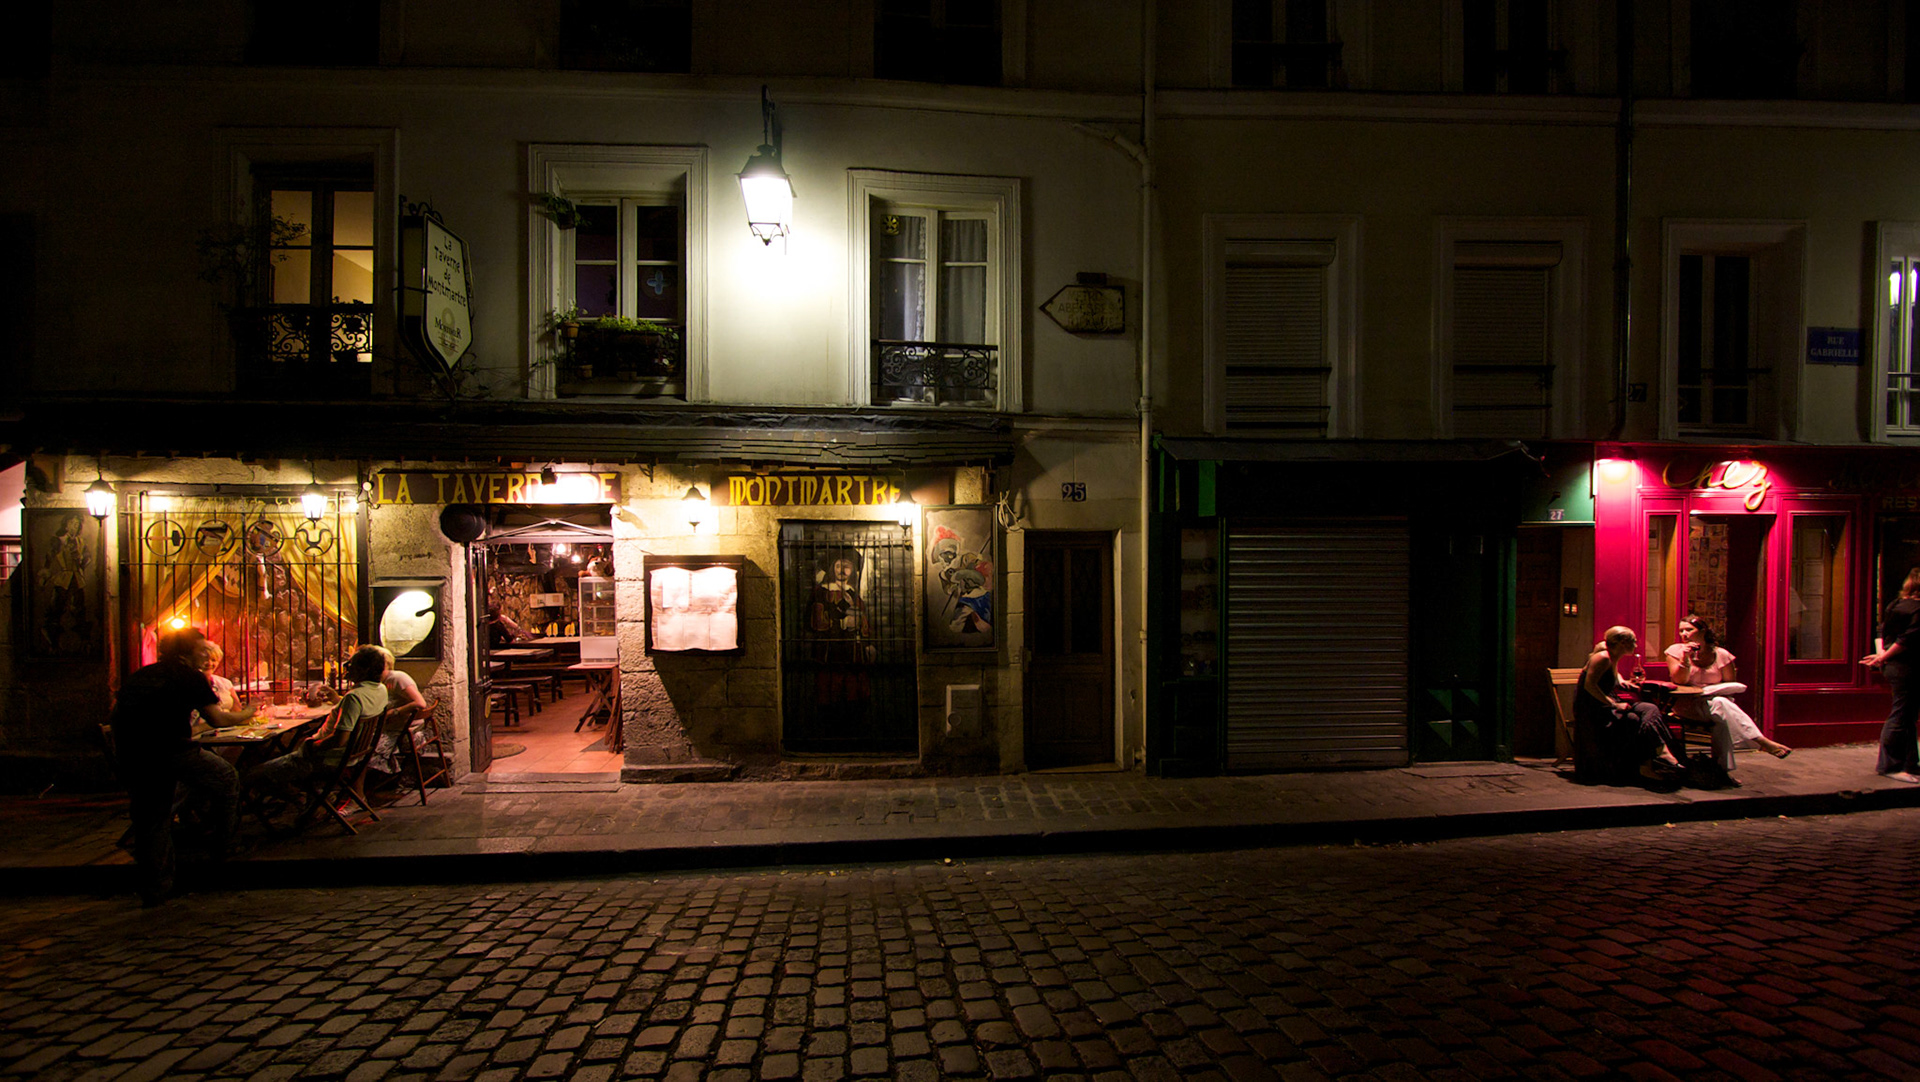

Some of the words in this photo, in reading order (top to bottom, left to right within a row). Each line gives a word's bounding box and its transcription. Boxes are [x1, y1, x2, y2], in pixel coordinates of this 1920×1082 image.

[444, 235, 453, 251] La
[434, 245, 460, 274] Taverne
[444, 268, 452, 285] de
[428, 275, 467, 307] Montmartre
[1827, 335, 1845, 345] RUE
[1810, 347, 1859, 358] GABRIELLE
[377, 474, 414, 503] LA
[728, 476, 902, 506] MONTMARTRE
[1062, 483, 1085, 501] 25
[1662, 453, 1772, 511] Chez
